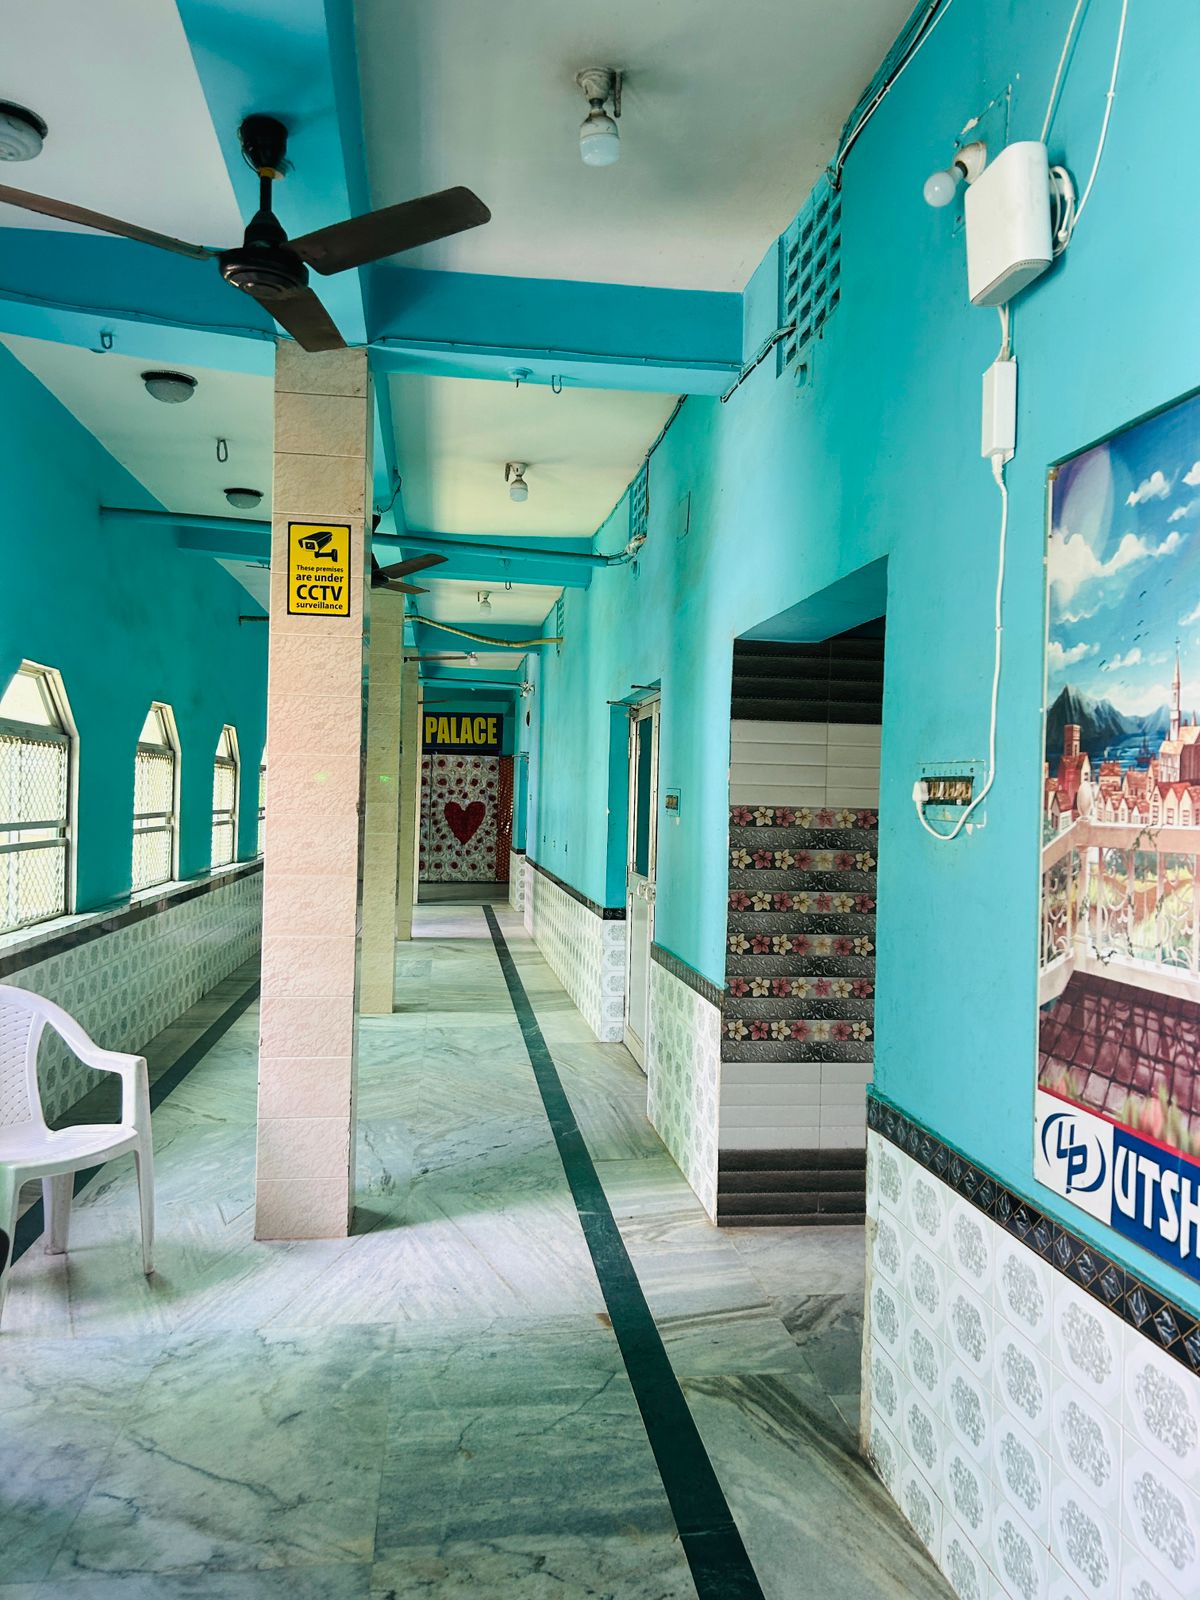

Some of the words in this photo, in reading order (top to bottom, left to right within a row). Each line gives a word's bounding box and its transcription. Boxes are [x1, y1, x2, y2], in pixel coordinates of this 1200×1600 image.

[296, 573, 312, 581] are
[314, 573, 344, 582] under
[296, 584, 343, 601] CCTV
[425, 716, 498, 745] PALACE
